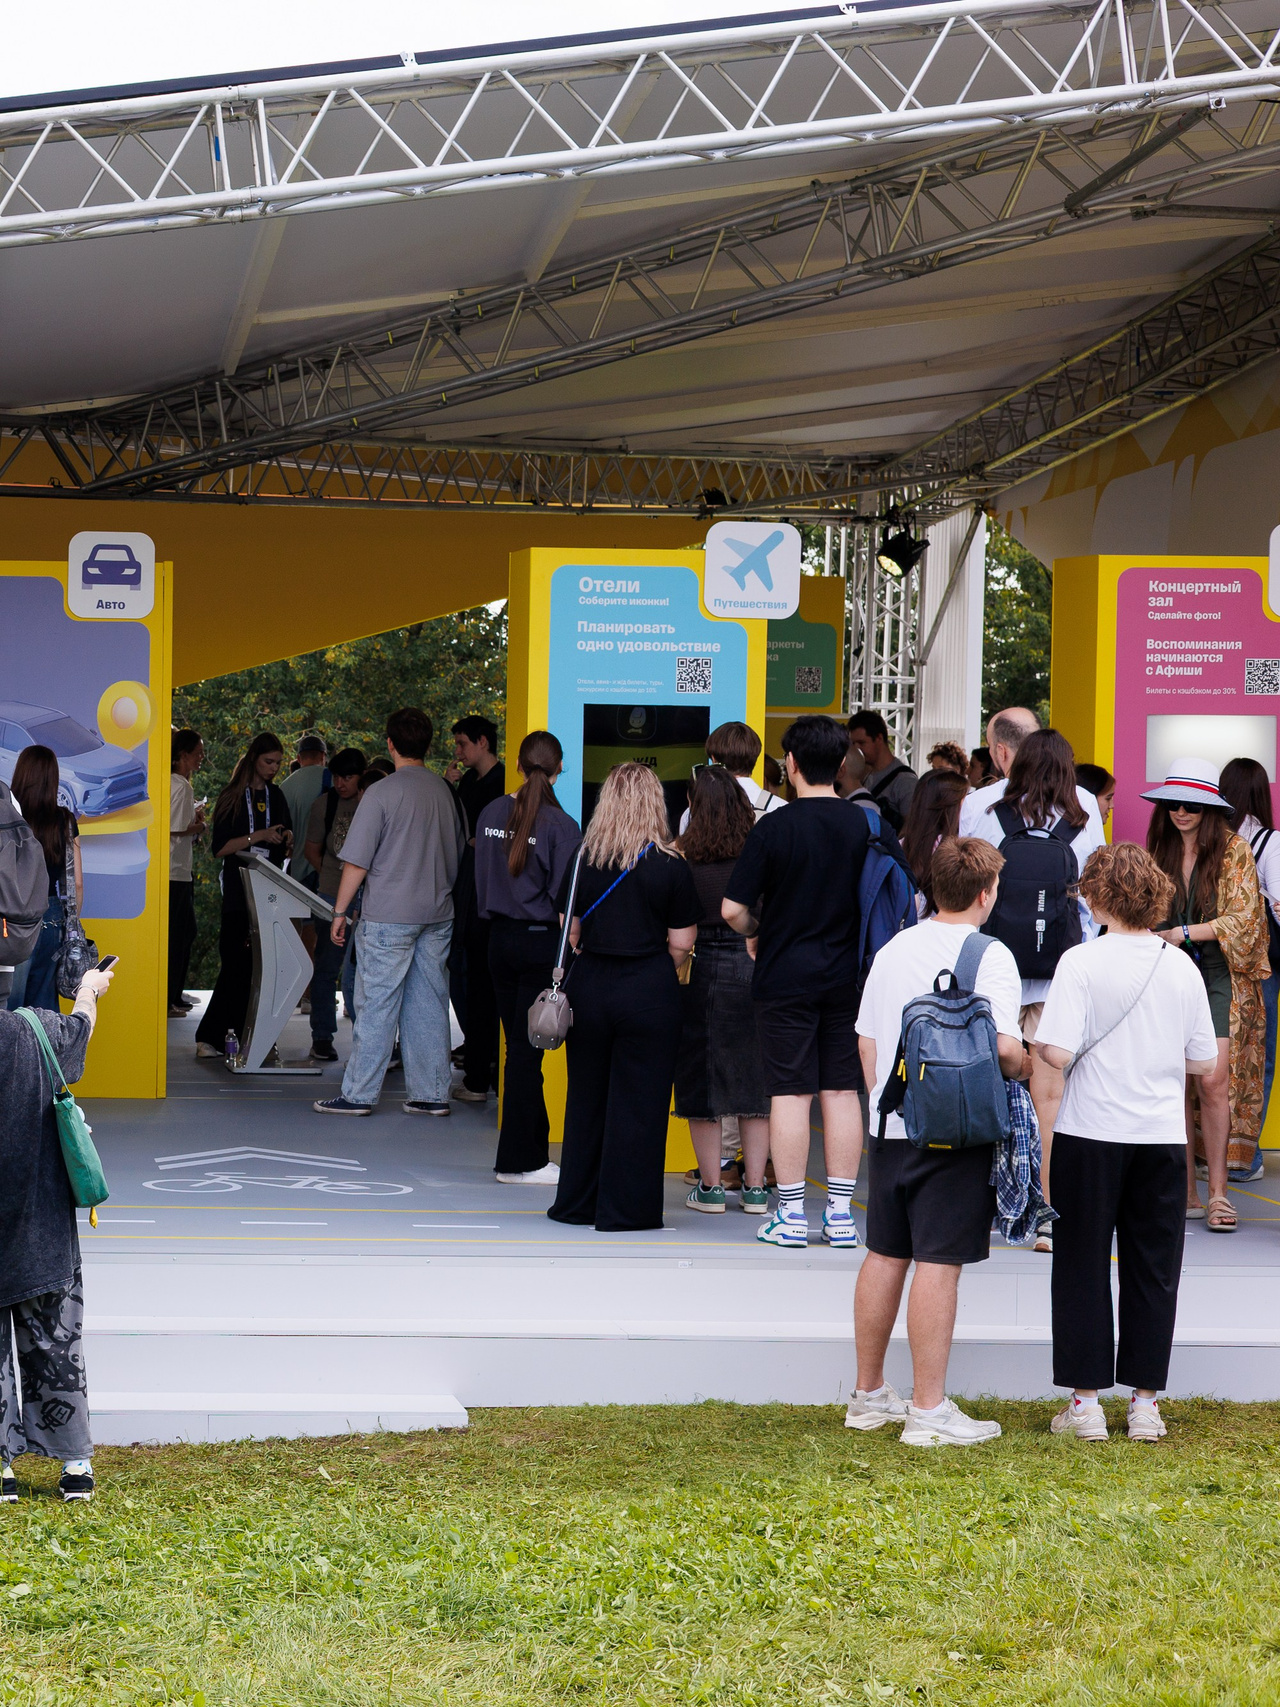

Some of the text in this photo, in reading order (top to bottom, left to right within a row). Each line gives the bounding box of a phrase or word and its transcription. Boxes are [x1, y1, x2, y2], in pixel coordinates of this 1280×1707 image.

[579, 577, 640, 593] Отели
[1149, 580, 1241, 595] Концертный
[96, 599, 126, 610] Авто
[578, 596, 669, 606] Соберите иконки!
[714, 598, 787, 610] Путешествия
[1148, 597, 1173, 607] зал
[1148, 611, 1221, 621] Сделайте фото!
[577, 621, 676, 635] Планировать
[577, 640, 721, 653] одно удовольствие
[1146, 639, 1242, 650] Воспоминания
[1146, 653, 1223, 663] начинаются
[1146, 665, 1202, 678] с Афиши
[1146, 687, 1170, 695] Билеты
[1178, 687, 1211, 695] кэшбэком
[1222, 687, 1236, 695] 30%
[1037, 889, 1046, 912] THULE
